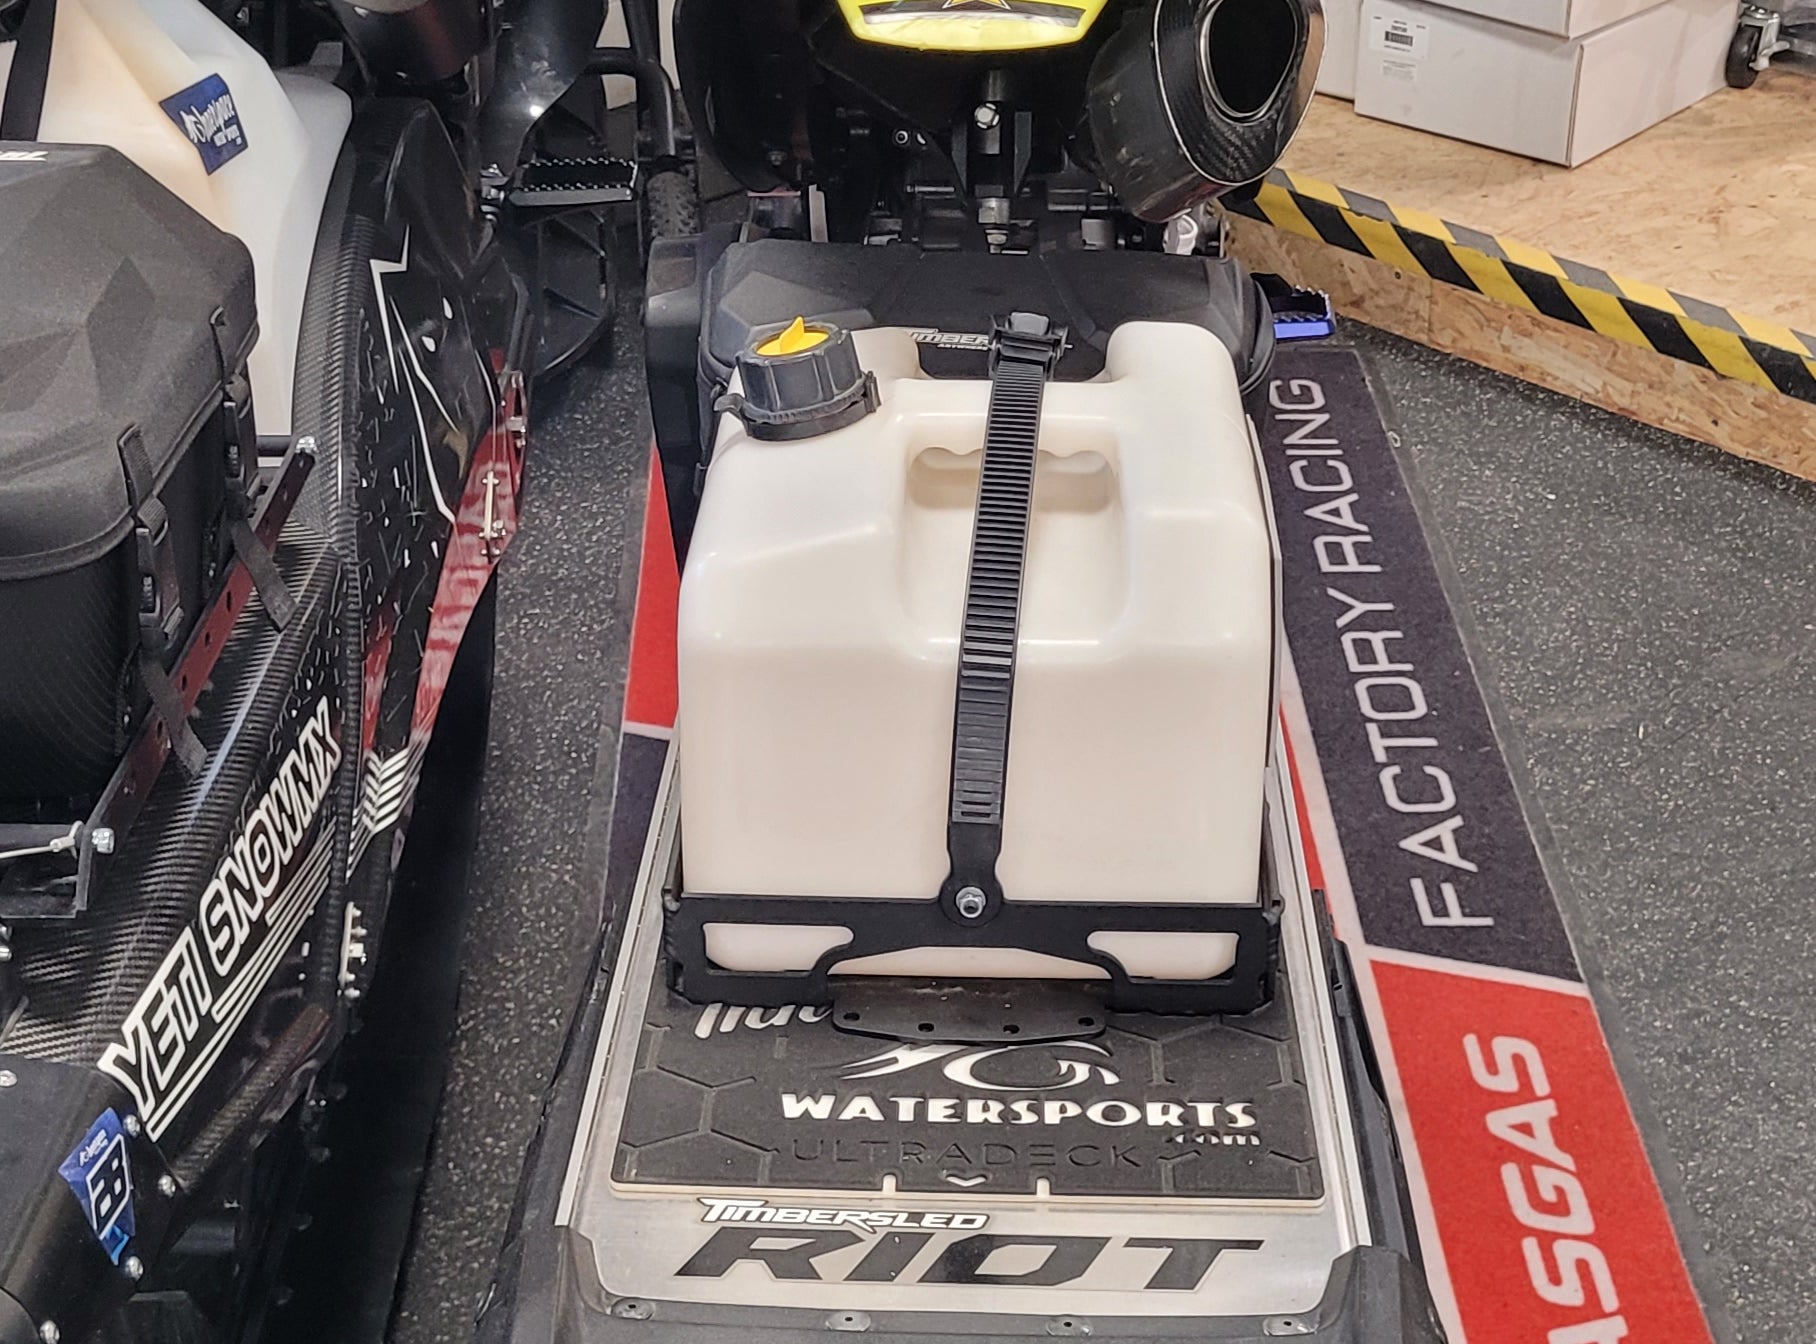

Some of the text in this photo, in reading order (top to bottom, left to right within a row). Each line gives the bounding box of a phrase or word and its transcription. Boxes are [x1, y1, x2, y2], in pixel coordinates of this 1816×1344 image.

[1268, 377, 1495, 928] FACTORY RACING
[99, 695, 342, 1122] YETI SNOWMX
[780, 1092, 1258, 1130] WATERSPORTS
[792, 1138, 1143, 1169] ULTRADECK
[672, 1225, 1265, 1292] RIOT
